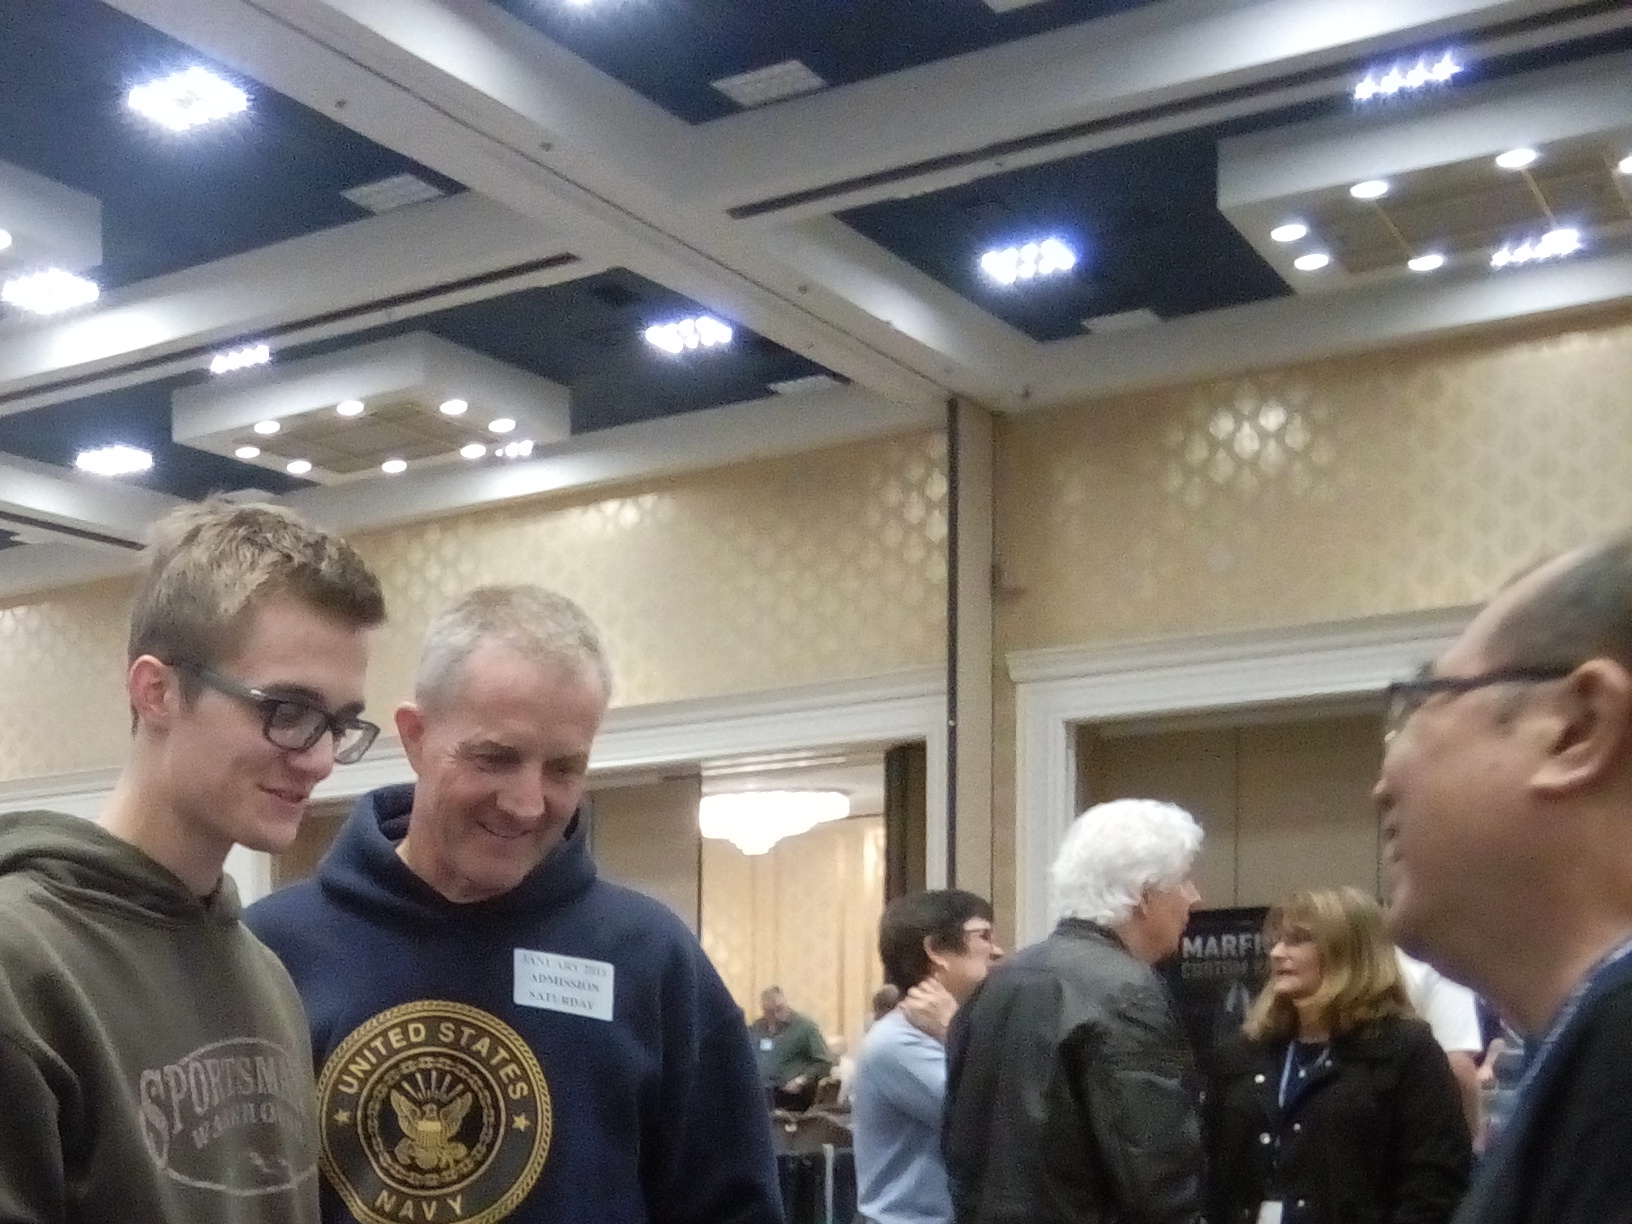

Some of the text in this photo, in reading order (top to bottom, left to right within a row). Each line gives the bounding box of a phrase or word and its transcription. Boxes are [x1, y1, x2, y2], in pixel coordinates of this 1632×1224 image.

[531, 973, 600, 992] ADMISSION
[528, 990, 594, 1011] SATURDAY
[338, 1022, 530, 1101] UNITED STATES
[373, 1189, 465, 1220] NAVY
